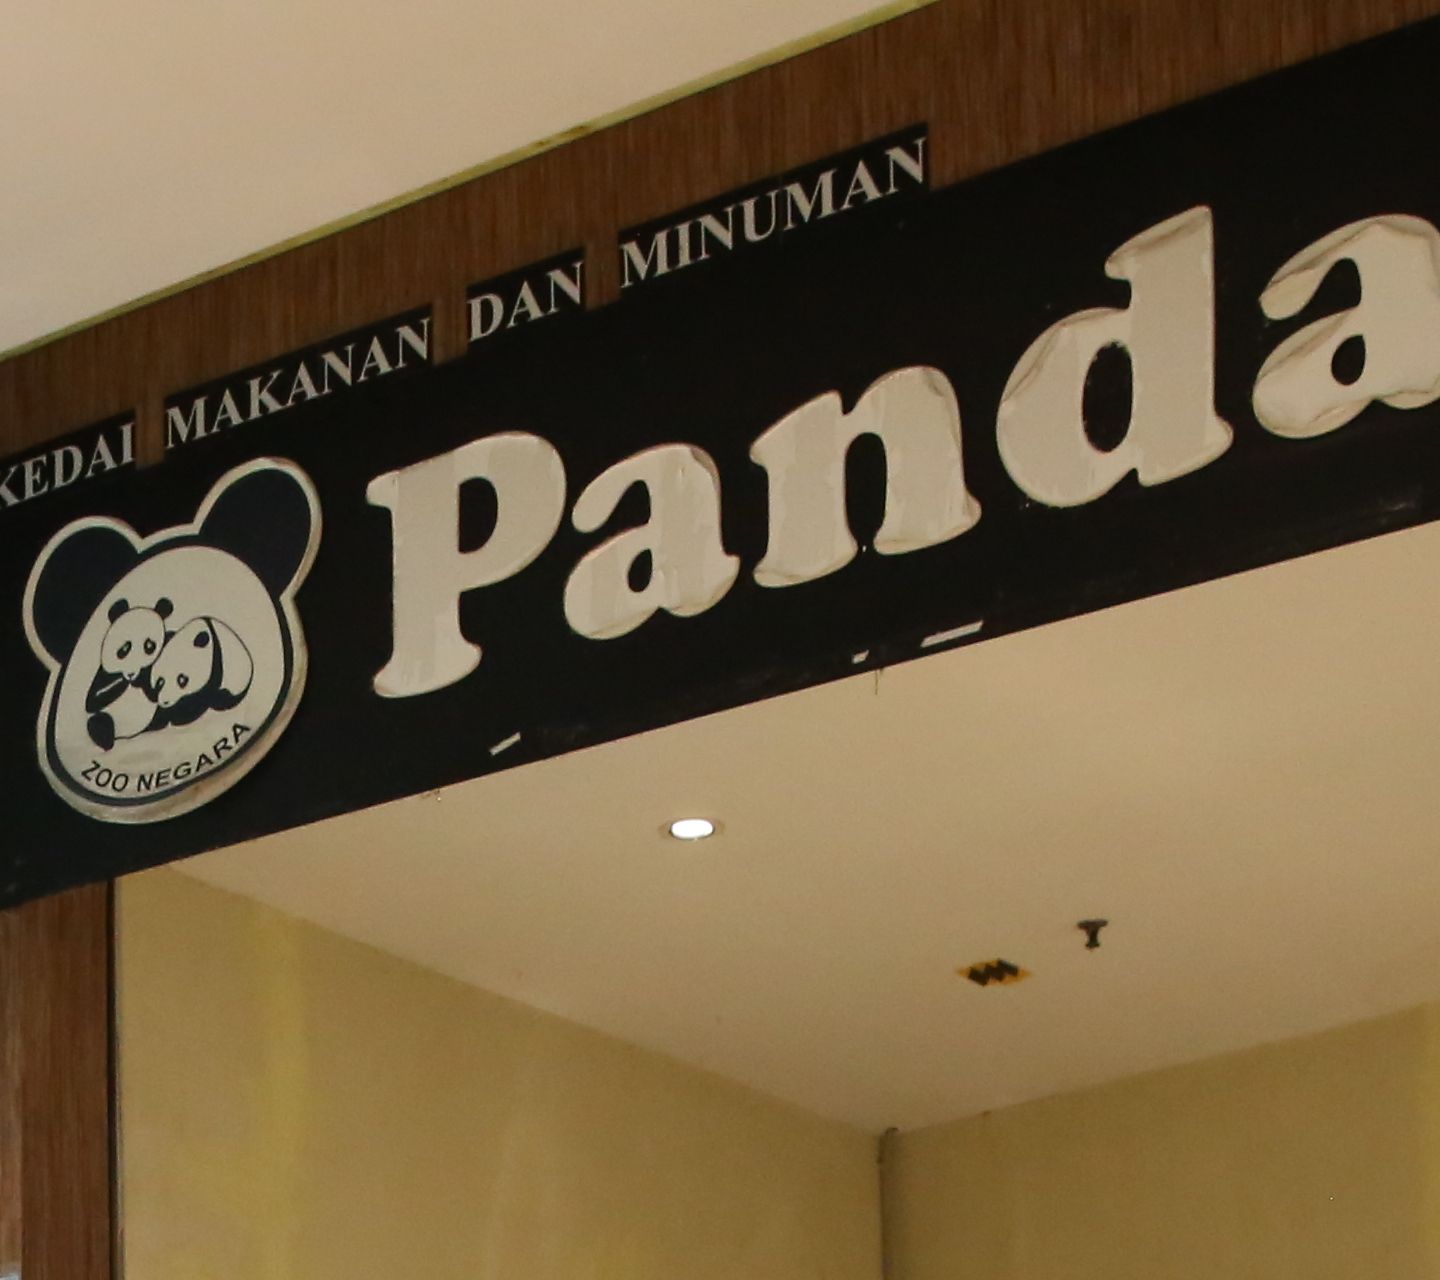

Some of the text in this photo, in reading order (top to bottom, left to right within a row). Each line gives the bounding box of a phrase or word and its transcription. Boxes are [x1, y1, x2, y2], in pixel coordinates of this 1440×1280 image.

[165, 319, 432, 451] MAKANAN
[467, 259, 585, 343] DAN
[617, 137, 928, 288] MINUMAN
[81, 723, 250, 792] ZOO NEGARA
